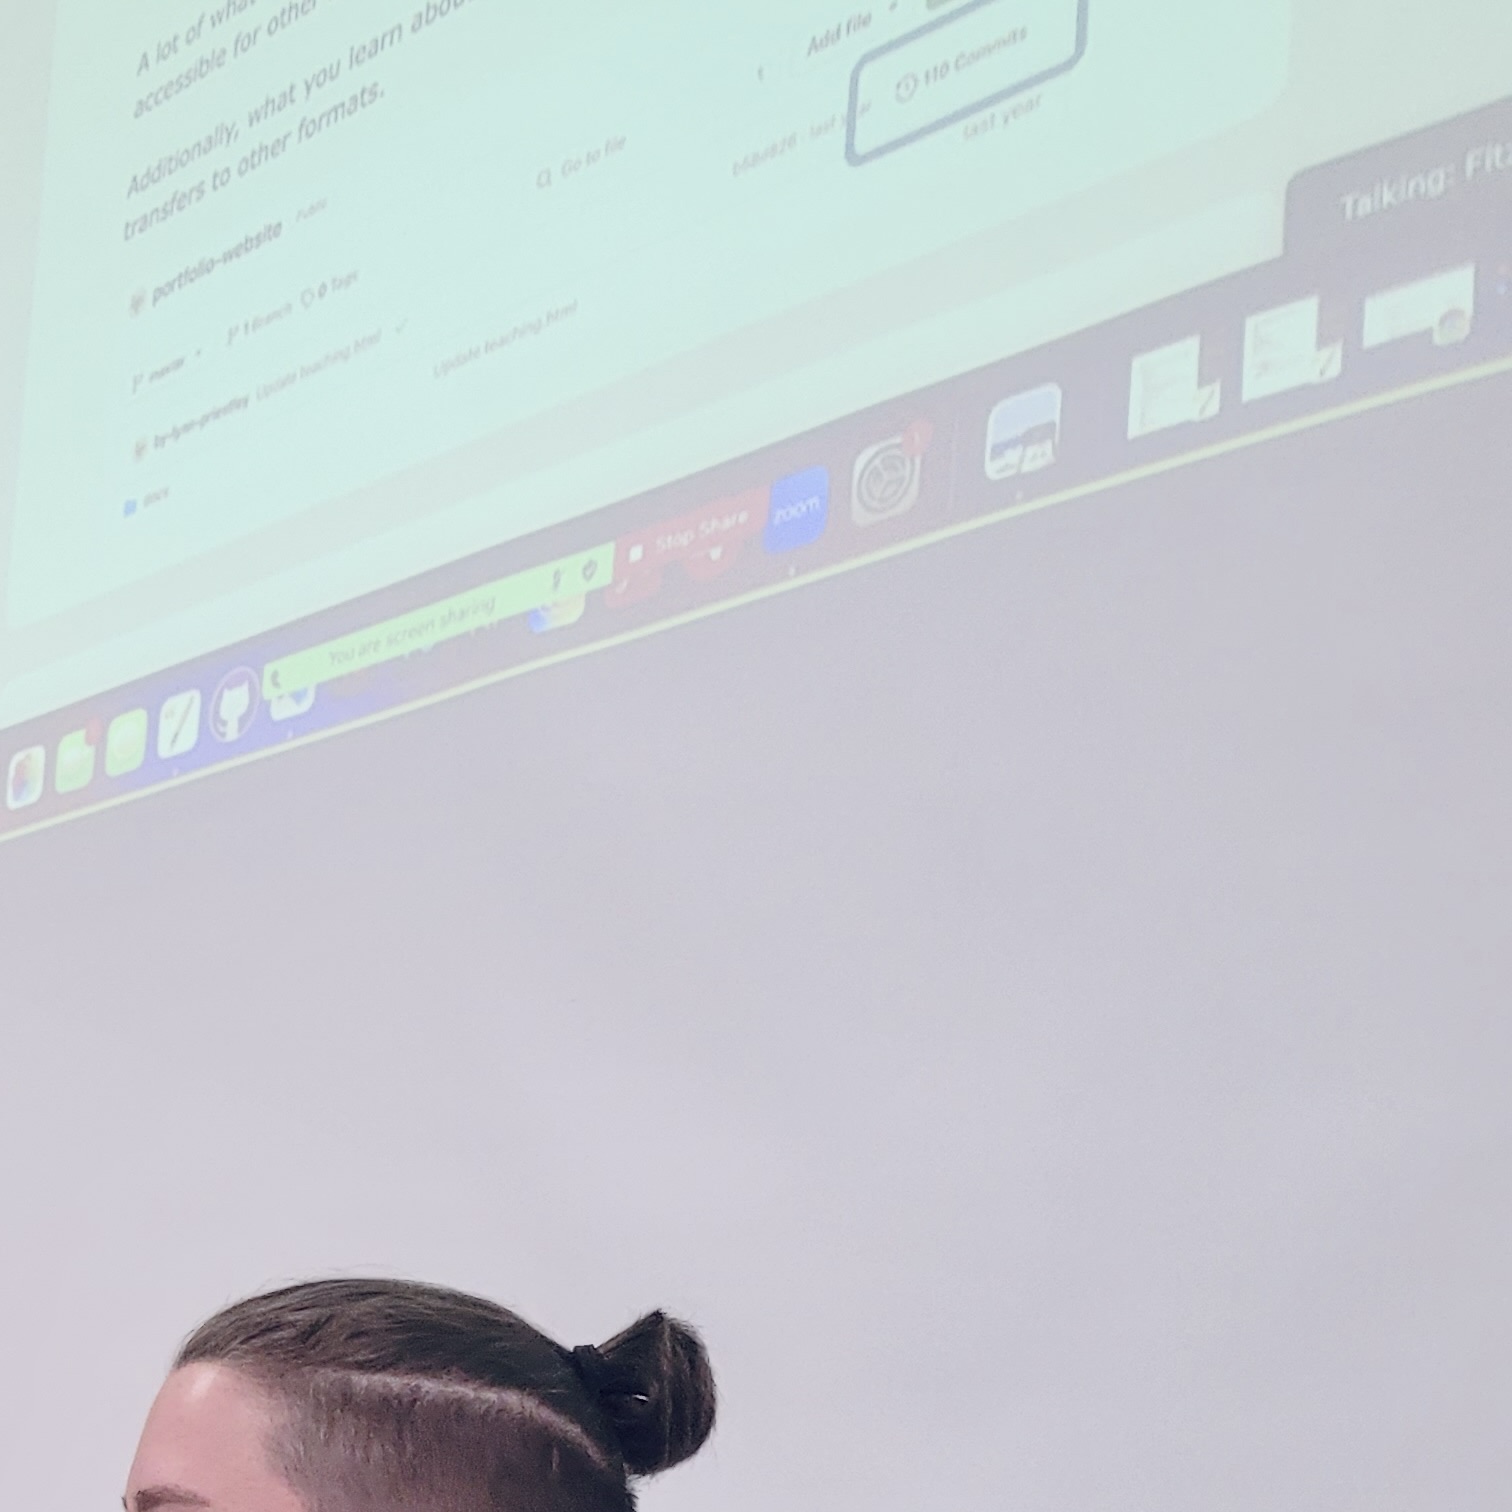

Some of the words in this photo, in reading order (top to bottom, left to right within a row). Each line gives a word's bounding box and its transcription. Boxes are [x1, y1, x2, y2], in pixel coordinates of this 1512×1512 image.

[132, 47, 228, 121] accessible
[232, 25, 262, 60] for
[135, 50, 151, 78] A
[155, 33, 180, 66] lot
[184, 10, 206, 48] of
[209, 0, 257, 29] wha
[806, 28, 843, 58] Add
[845, 11, 873, 38] file
[126, 121, 232, 200] Additionally,
[247, 82, 297, 130] what
[303, 58, 342, 102] you
[348, 22, 405, 72] learn
[123, 179, 206, 241] transfers
[211, 166, 233, 193] to
[236, 130, 294, 178] other
[297, 81, 385, 145] formats.
[151, 220, 284, 308] portfolio-website
[657, 530, 695, 551] Stop
[699, 511, 748, 535] Share
[774, 496, 821, 525] zoom
